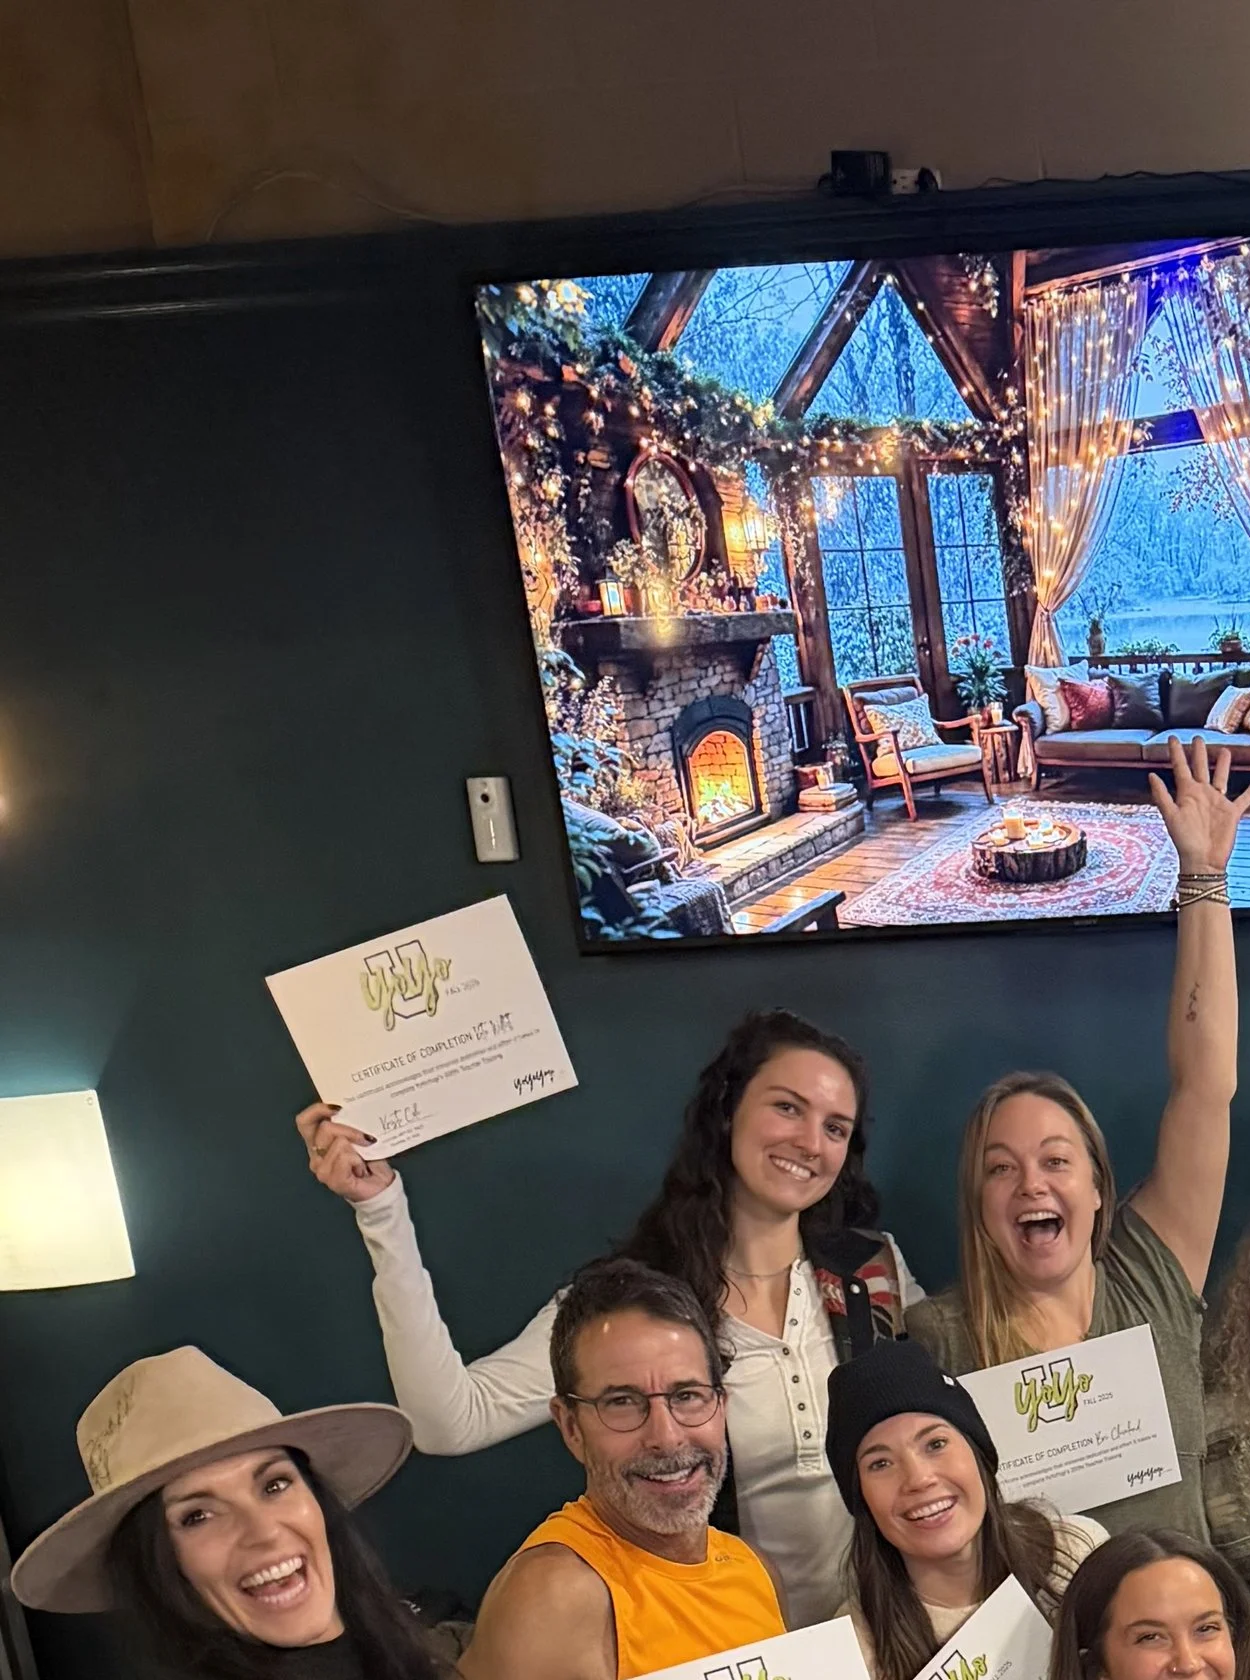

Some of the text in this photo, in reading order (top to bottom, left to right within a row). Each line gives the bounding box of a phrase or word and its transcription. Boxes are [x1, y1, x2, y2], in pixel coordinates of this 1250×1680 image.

[351, 1056, 406, 1082] CERTIFICATE
[406, 1051, 416, 1063] OF
[420, 1032, 473, 1058] COMPLETION
[1014, 1365, 1094, 1433] YoYo
[998, 1455, 1034, 1472] RTIFICATE
[1035, 1451, 1045, 1461] OF
[1047, 1438, 1093, 1457] COMPLETION
